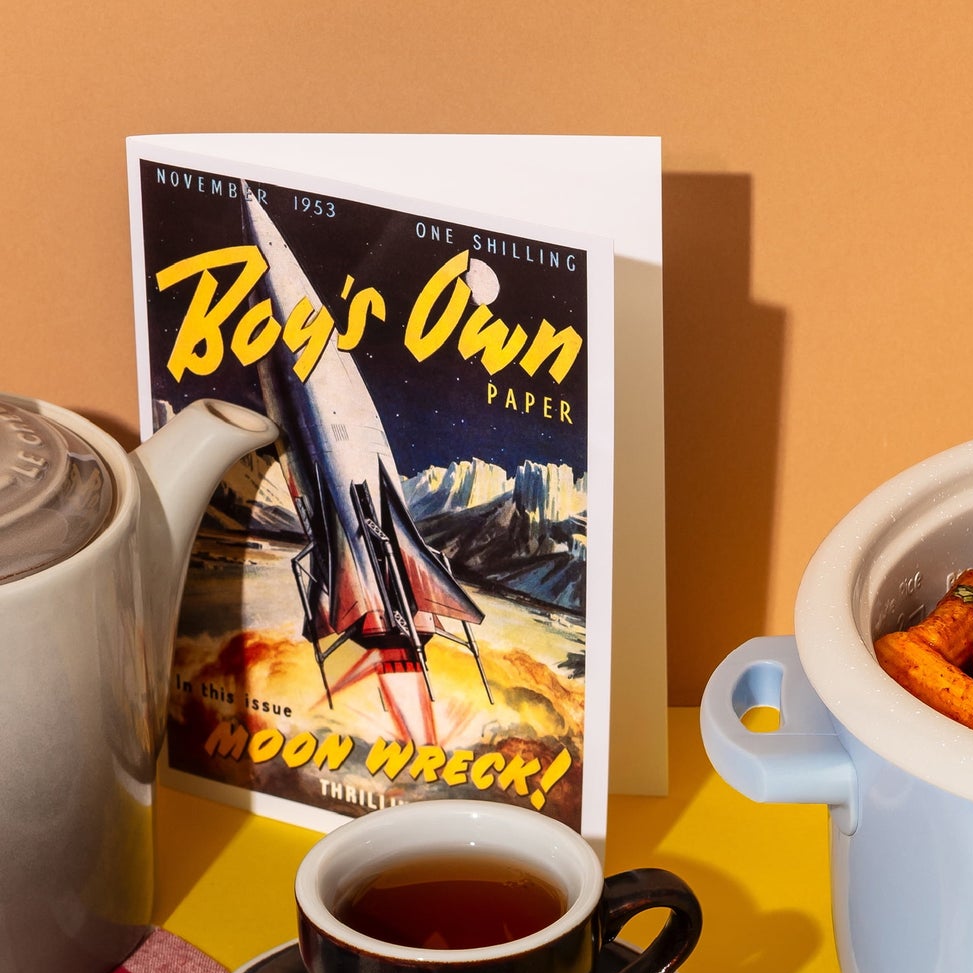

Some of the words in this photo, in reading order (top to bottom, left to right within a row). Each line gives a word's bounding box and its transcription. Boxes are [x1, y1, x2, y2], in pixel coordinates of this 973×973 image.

[156, 167, 268, 204] NOVEMBER
[293, 195, 337, 219] 1953
[416, 221, 454, 246] ONE
[473, 233, 577, 272] SHILLING
[155, 244, 386, 384] Boy's
[404, 248, 583, 384] Own
[487, 383, 573, 425] PAPER
[175, 673, 193, 692] In
[201, 682, 235, 705] this
[245, 693, 293, 718] issue
[204, 721, 355, 771] MOON
[365, 737, 572, 811] WRECK!
[319, 778, 409, 810] THRILL
